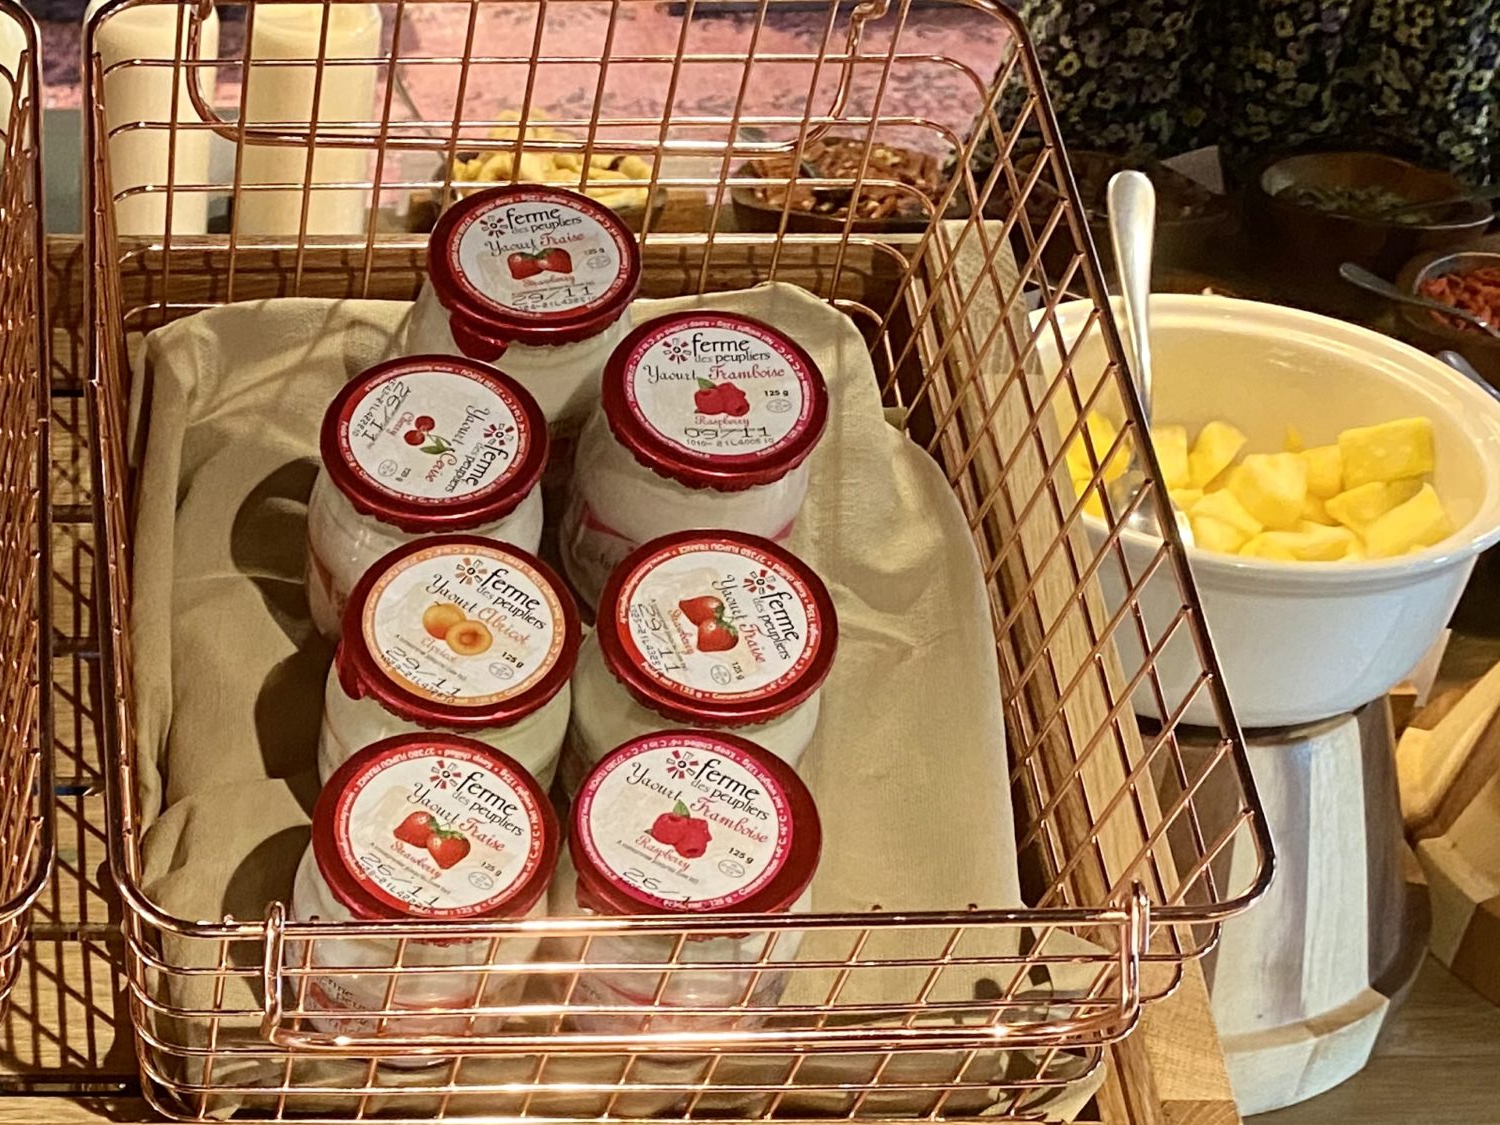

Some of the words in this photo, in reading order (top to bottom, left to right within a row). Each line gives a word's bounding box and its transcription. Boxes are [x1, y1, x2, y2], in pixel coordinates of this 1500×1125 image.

[507, 208, 560, 231] ferme
[531, 216, 582, 234] peupliers
[540, 233, 585, 246] Fraise
[692, 333, 750, 356] ferme
[715, 351, 770, 364] peupliers
[643, 365, 696, 384] Yaourt
[709, 364, 785, 380] Framboise
[467, 445, 509, 487] ferme
[425, 573, 477, 613] Yaourt
[480, 568, 540, 612] ferme
[492, 592, 546, 630] peupliers
[712, 574, 747, 621] Yaourt
[739, 623, 765, 663] Fraise
[761, 591, 800, 640] ferme
[758, 614, 791, 660] peupliers
[456, 771, 518, 817] ferme
[690, 779, 710, 791] des
[709, 789, 770, 821] peupliers
[694, 758, 760, 801] ferme
[406, 782, 460, 824] Yaourt
[459, 817, 505, 852] Fraise
[469, 799, 524, 836] peupliers
[626, 761, 683, 801] Yaourt
[690, 796, 768, 844] Framboise
[728, 847, 745, 858] 125
